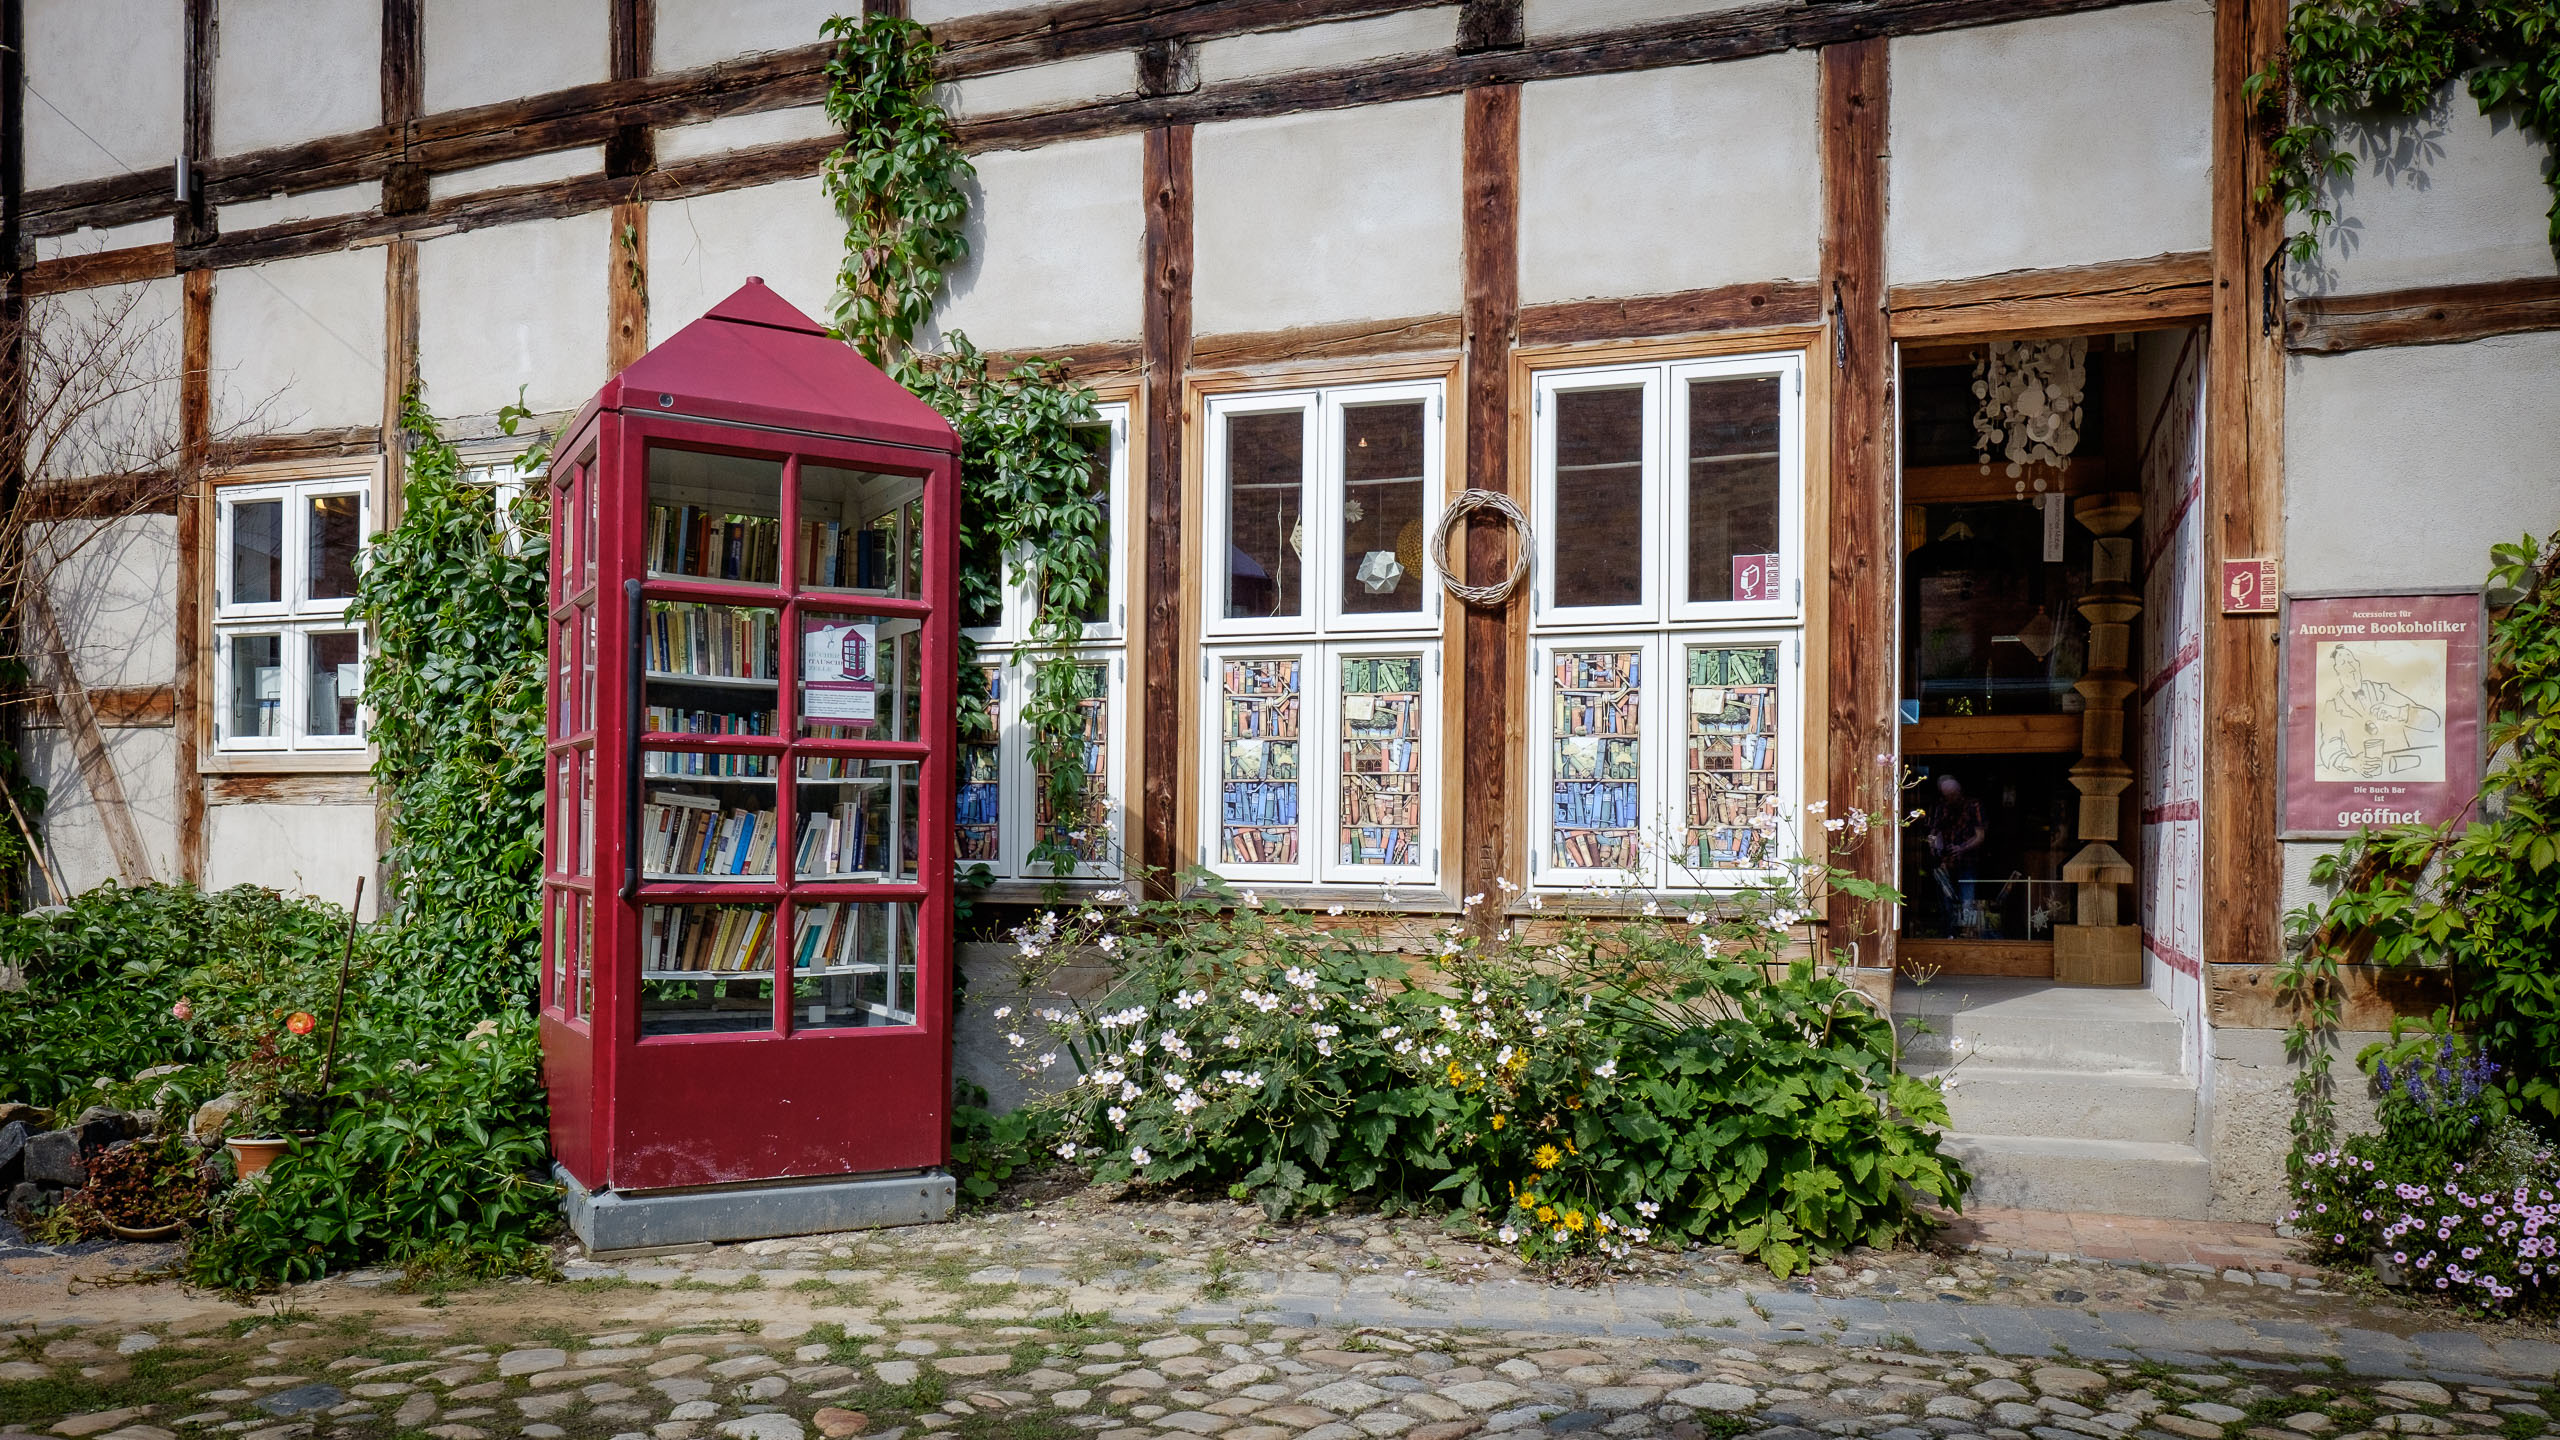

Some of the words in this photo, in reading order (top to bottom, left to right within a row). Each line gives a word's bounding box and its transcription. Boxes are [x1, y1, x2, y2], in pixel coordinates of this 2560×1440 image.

[1766, 554, 1779, 568] Bar
[2261, 560, 2276, 575] Bar
[1766, 570, 1779, 586] Buch
[2261, 576, 2276, 595] Buch
[1767, 588, 1779, 600] Die
[2261, 597, 2276, 610] Die
[2352, 610, 2397, 618] Accessoires
[2399, 610, 2412, 618] für
[2299, 623, 2366, 637] Anonyme
[2370, 620, 2467, 634] Bookoholiker
[2353, 786, 2367, 794] Die
[2369, 786, 2389, 794] Buch
[2391, 786, 2406, 794] Bar
[2337, 808, 2422, 827] geöffnet
